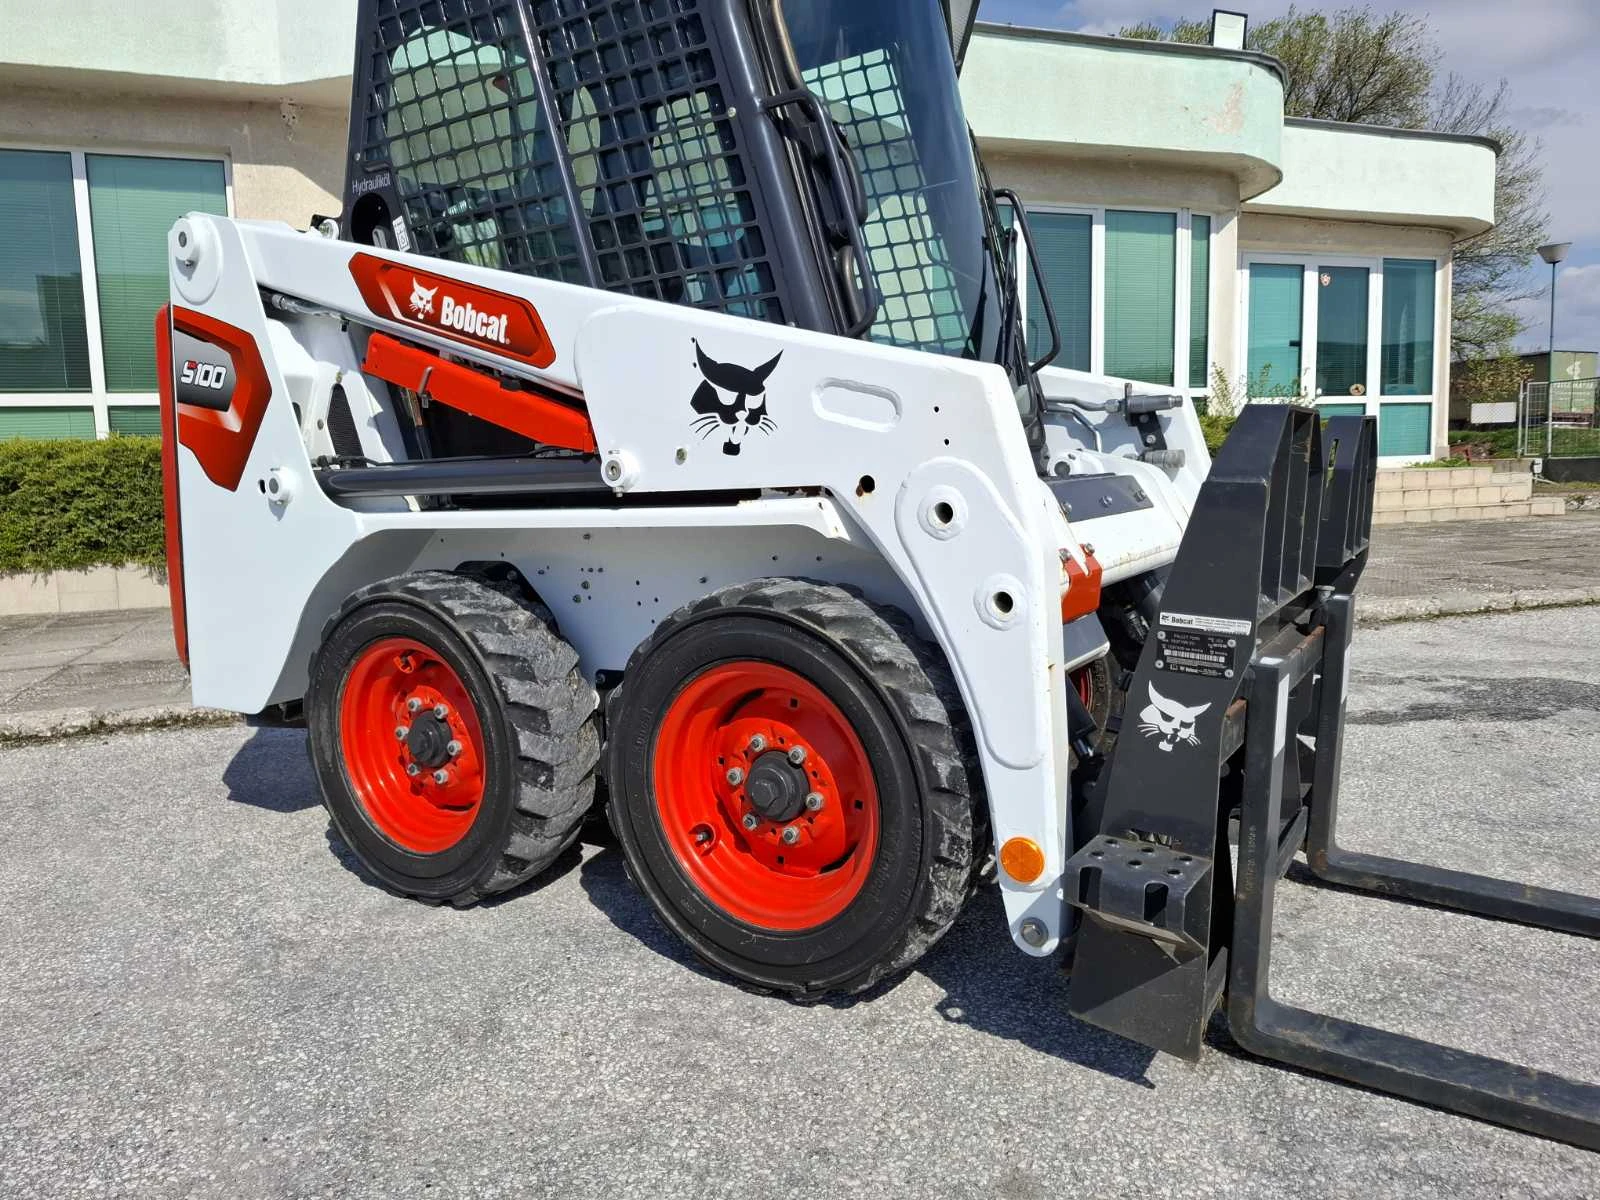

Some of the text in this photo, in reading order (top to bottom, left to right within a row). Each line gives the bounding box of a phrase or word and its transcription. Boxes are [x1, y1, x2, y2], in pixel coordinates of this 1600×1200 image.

[352, 172, 391, 195] Hydrauliköl
[440, 296, 508, 345] Bobcat
[181, 360, 227, 389] S100
[1171, 616, 1193, 625] Bobcat
